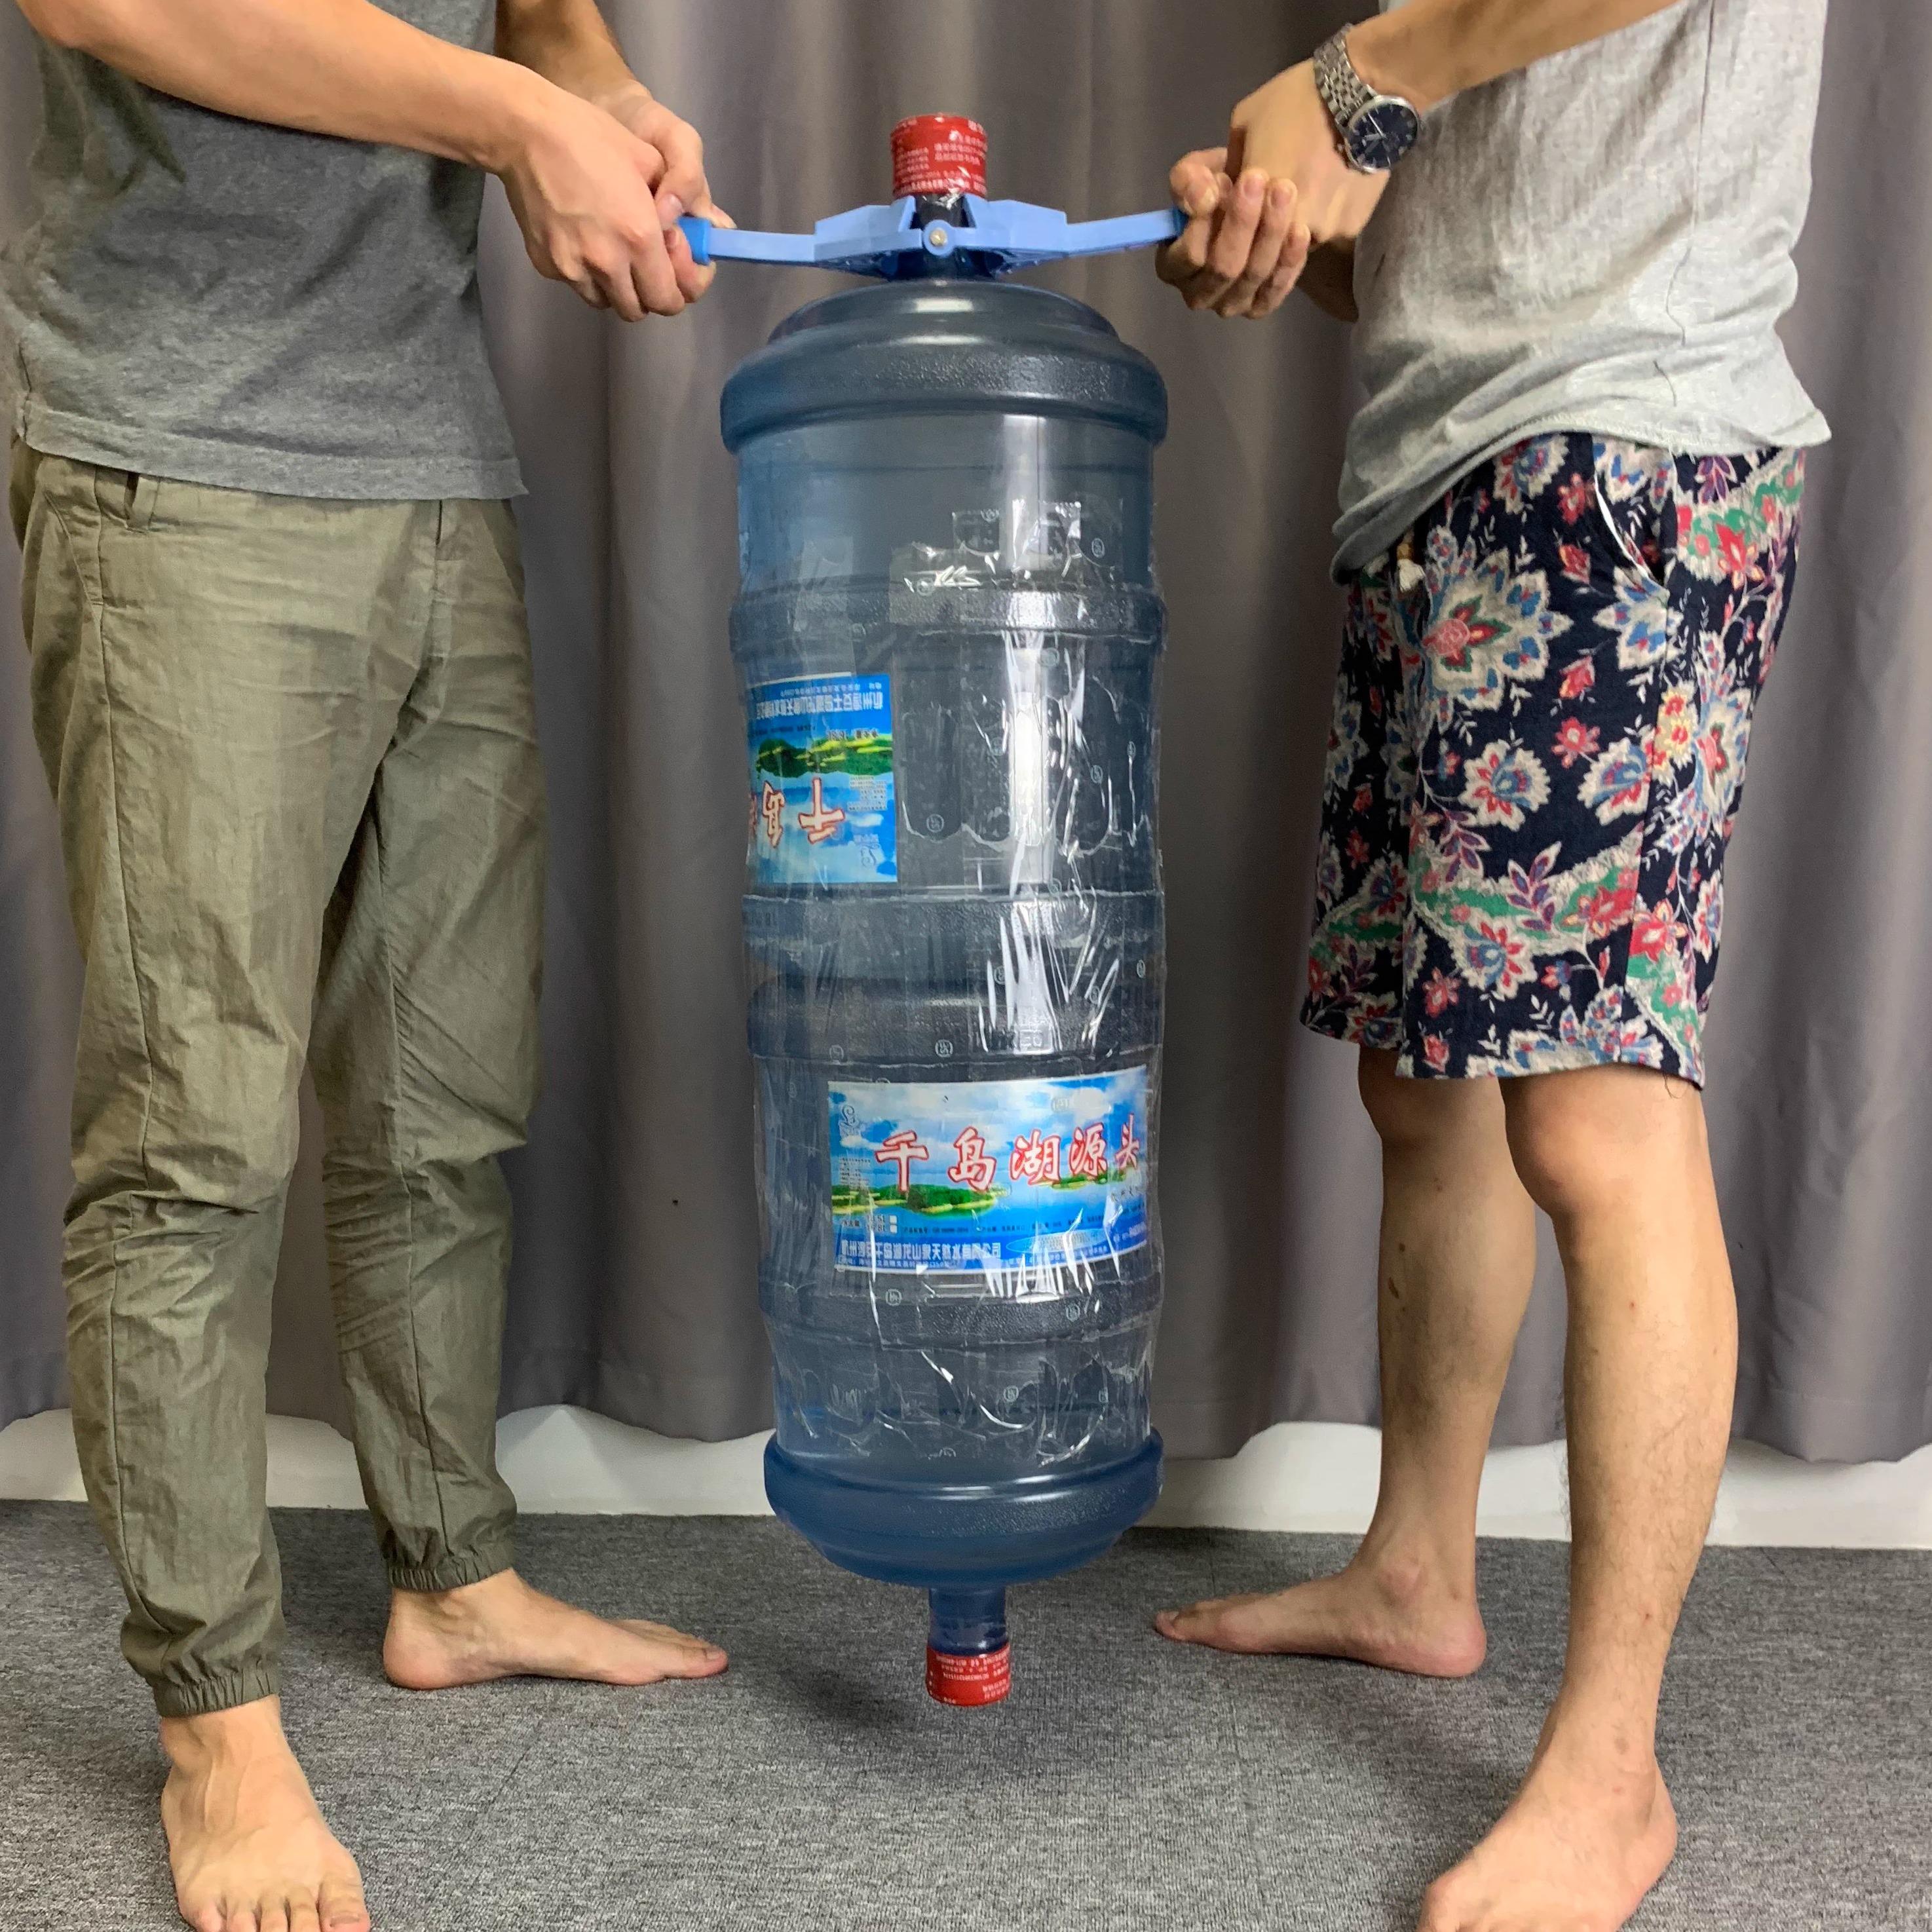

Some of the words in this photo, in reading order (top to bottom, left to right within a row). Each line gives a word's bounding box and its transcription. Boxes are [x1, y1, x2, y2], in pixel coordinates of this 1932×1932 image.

[875, 1112, 1140, 1194] 千岛湖源头
